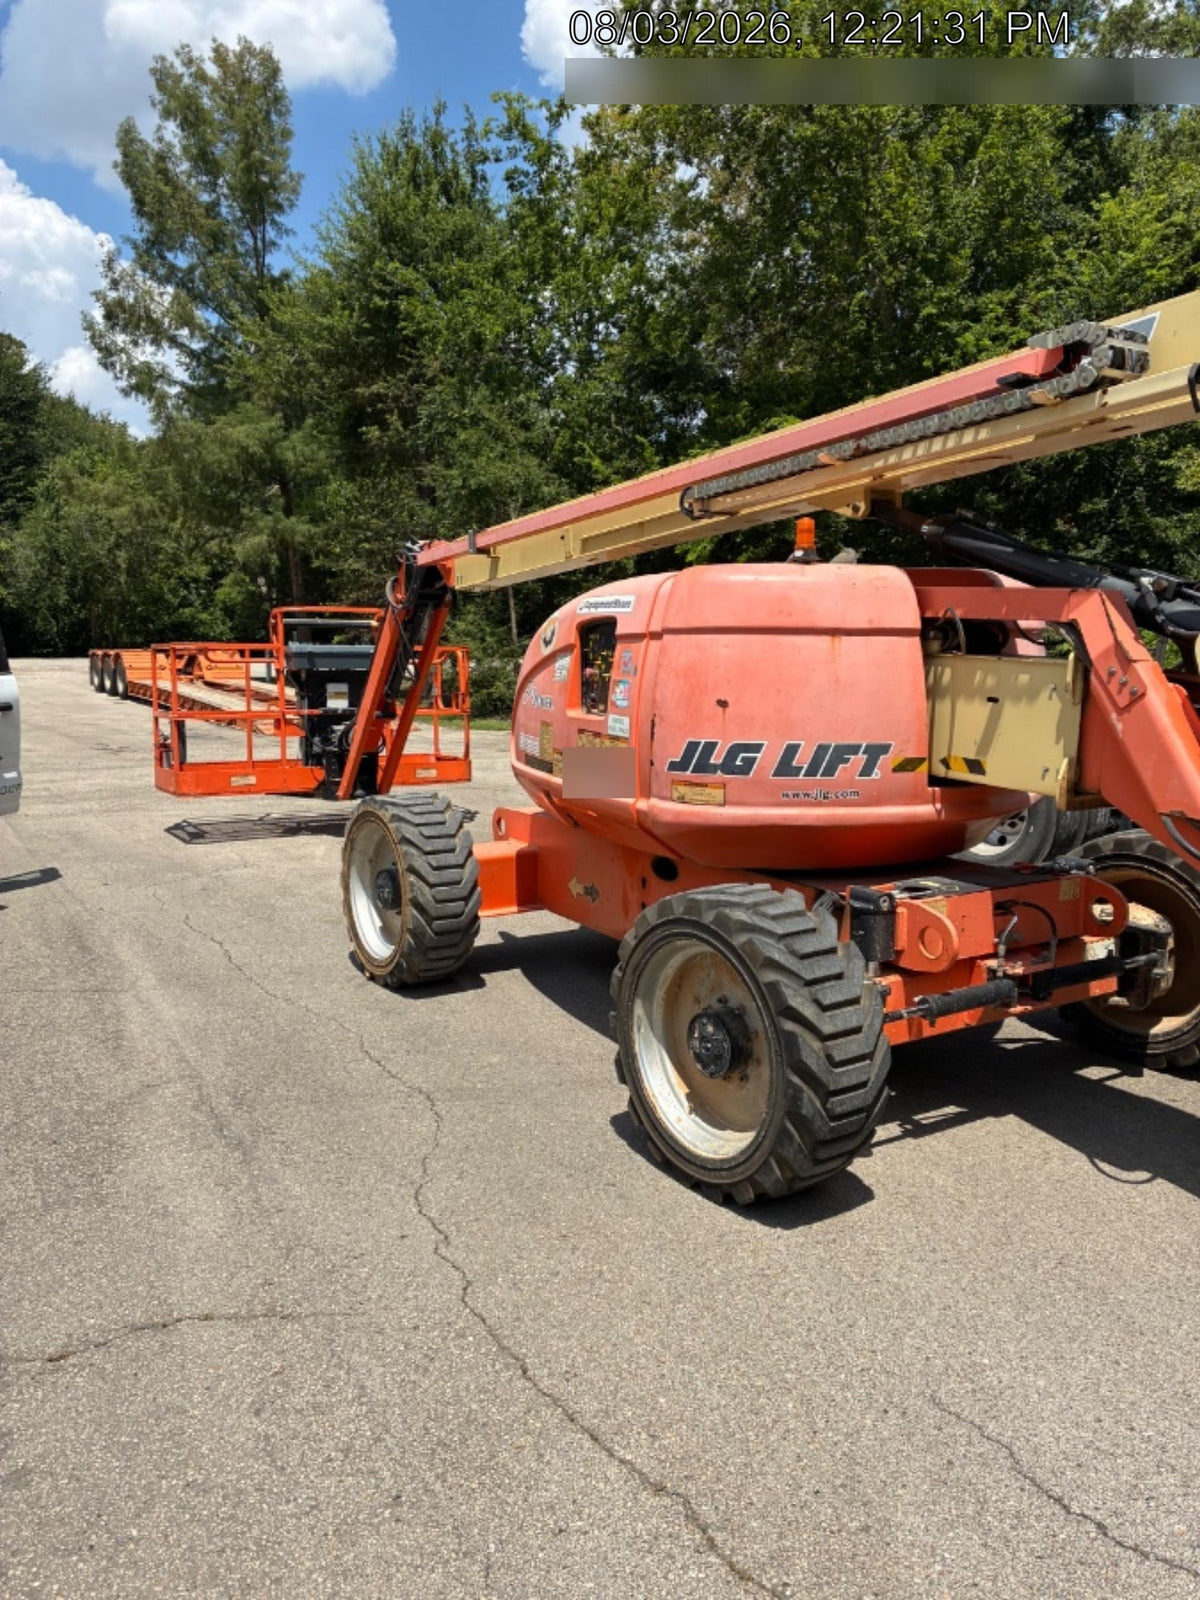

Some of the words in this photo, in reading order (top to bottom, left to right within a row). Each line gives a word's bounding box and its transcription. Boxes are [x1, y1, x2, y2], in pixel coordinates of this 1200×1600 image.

[666, 740, 767, 777] JLG
[769, 741, 894, 779] LIFT
[781, 789, 860, 801] www.jlg.com
